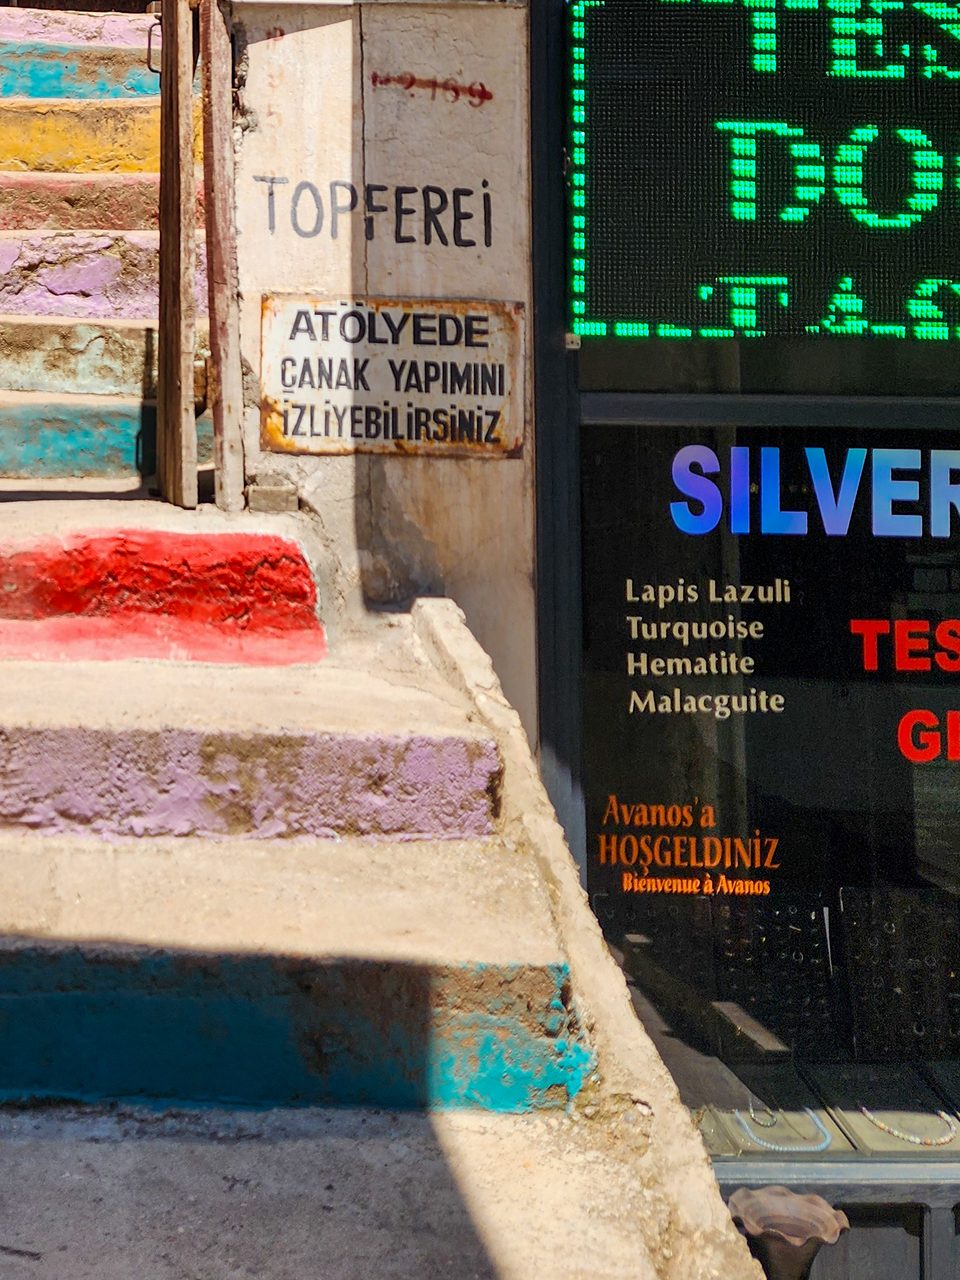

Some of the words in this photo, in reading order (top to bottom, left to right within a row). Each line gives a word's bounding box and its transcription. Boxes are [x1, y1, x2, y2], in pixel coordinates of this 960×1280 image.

[289, 301, 490, 348] ATÖLYEDE
[281, 357, 371, 394] ÇANAK
[387, 359, 505, 397] YAPIMINI
[670, 445, 960, 537] SILVER
[626, 578, 699, 608] Lapis
[709, 579, 791, 603] Lazuli
[626, 615, 764, 646] Turquoise
[627, 651, 755, 676] Hematite
[628, 688, 785, 719] Malacguite
[716, 873, 771, 896] Avanos
